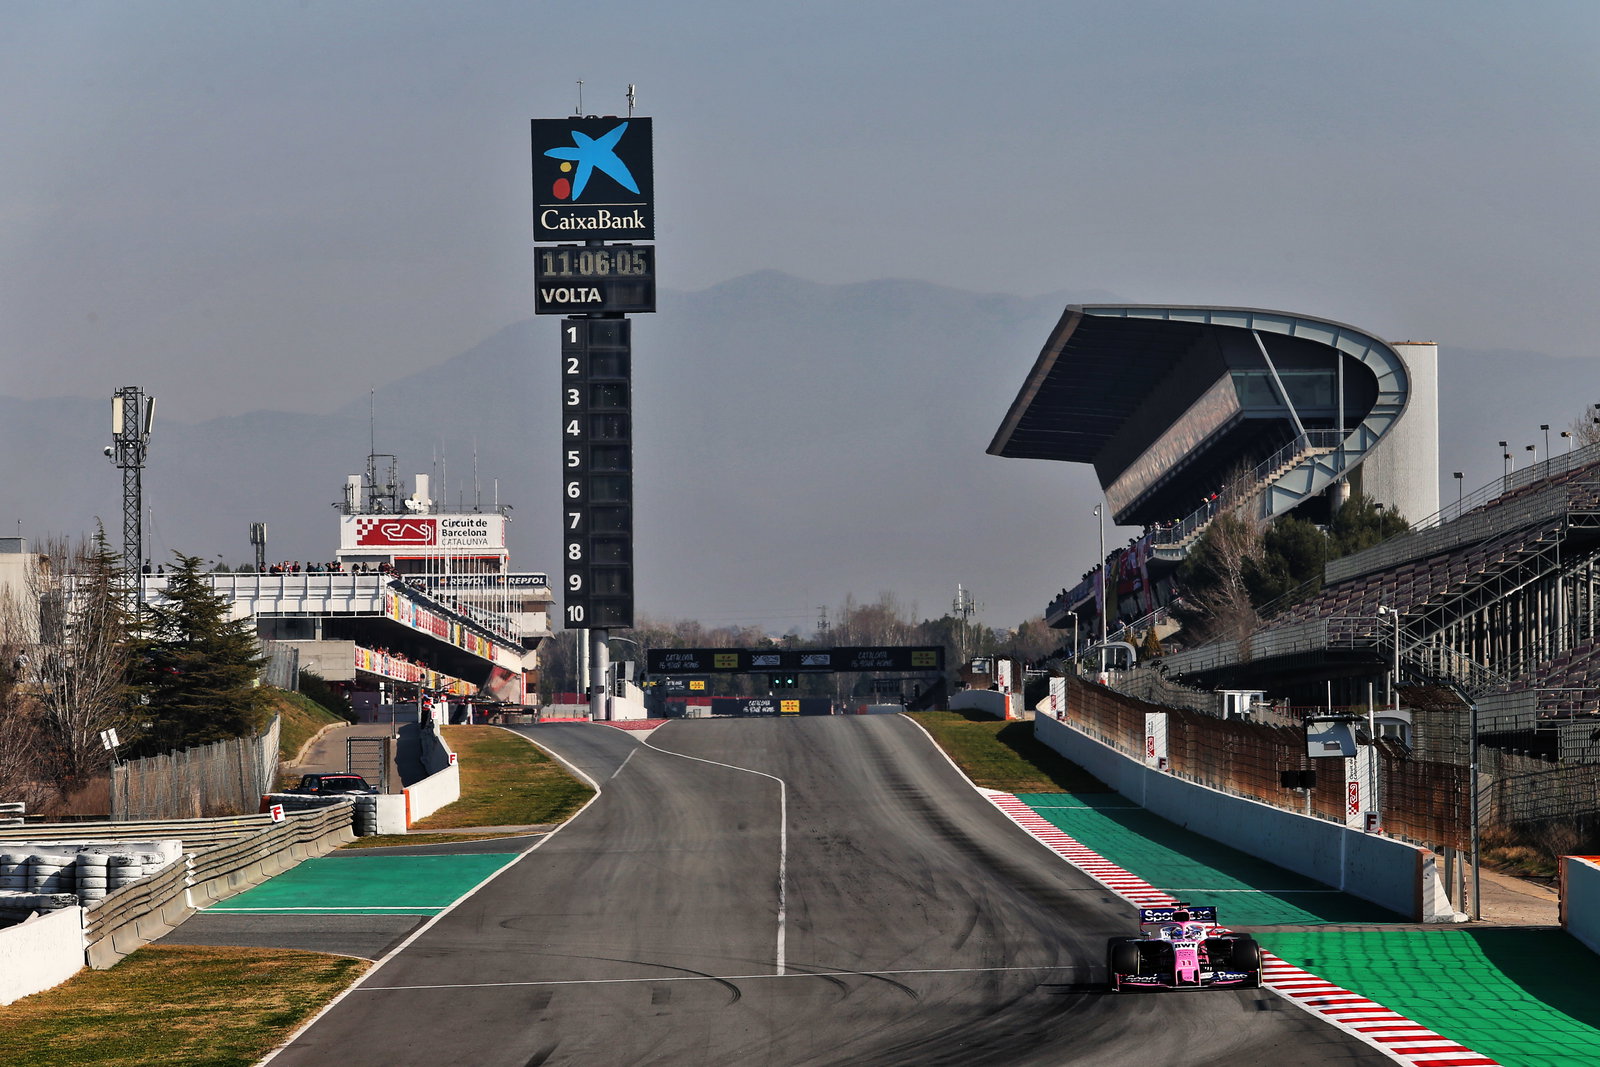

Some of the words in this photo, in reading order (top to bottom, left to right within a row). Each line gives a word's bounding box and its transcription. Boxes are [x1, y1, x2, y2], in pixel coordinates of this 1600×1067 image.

[541, 210, 646, 230] CaixaBank
[542, 250, 646, 276] 11:06:05
[541, 287, 602, 303] VOLTA
[567, 327, 577, 343] 1
[567, 358, 579, 374] 2
[567, 389, 580, 405] 3
[566, 420, 581, 436] 4
[567, 451, 580, 467] 5
[567, 482, 581, 498] 6
[441, 519, 474, 528] Circuit
[476, 519, 488, 528] de
[568, 513, 581, 529] 7
[441, 529, 487, 537] Barcelona
[568, 543, 582, 560] 8
[569, 574, 582, 591] 9
[567, 605, 584, 622] 10
[450, 754, 456, 764] F
[1159, 759, 1166, 768] F
[274, 806, 282, 820] F
[1366, 814, 1377, 830] F
